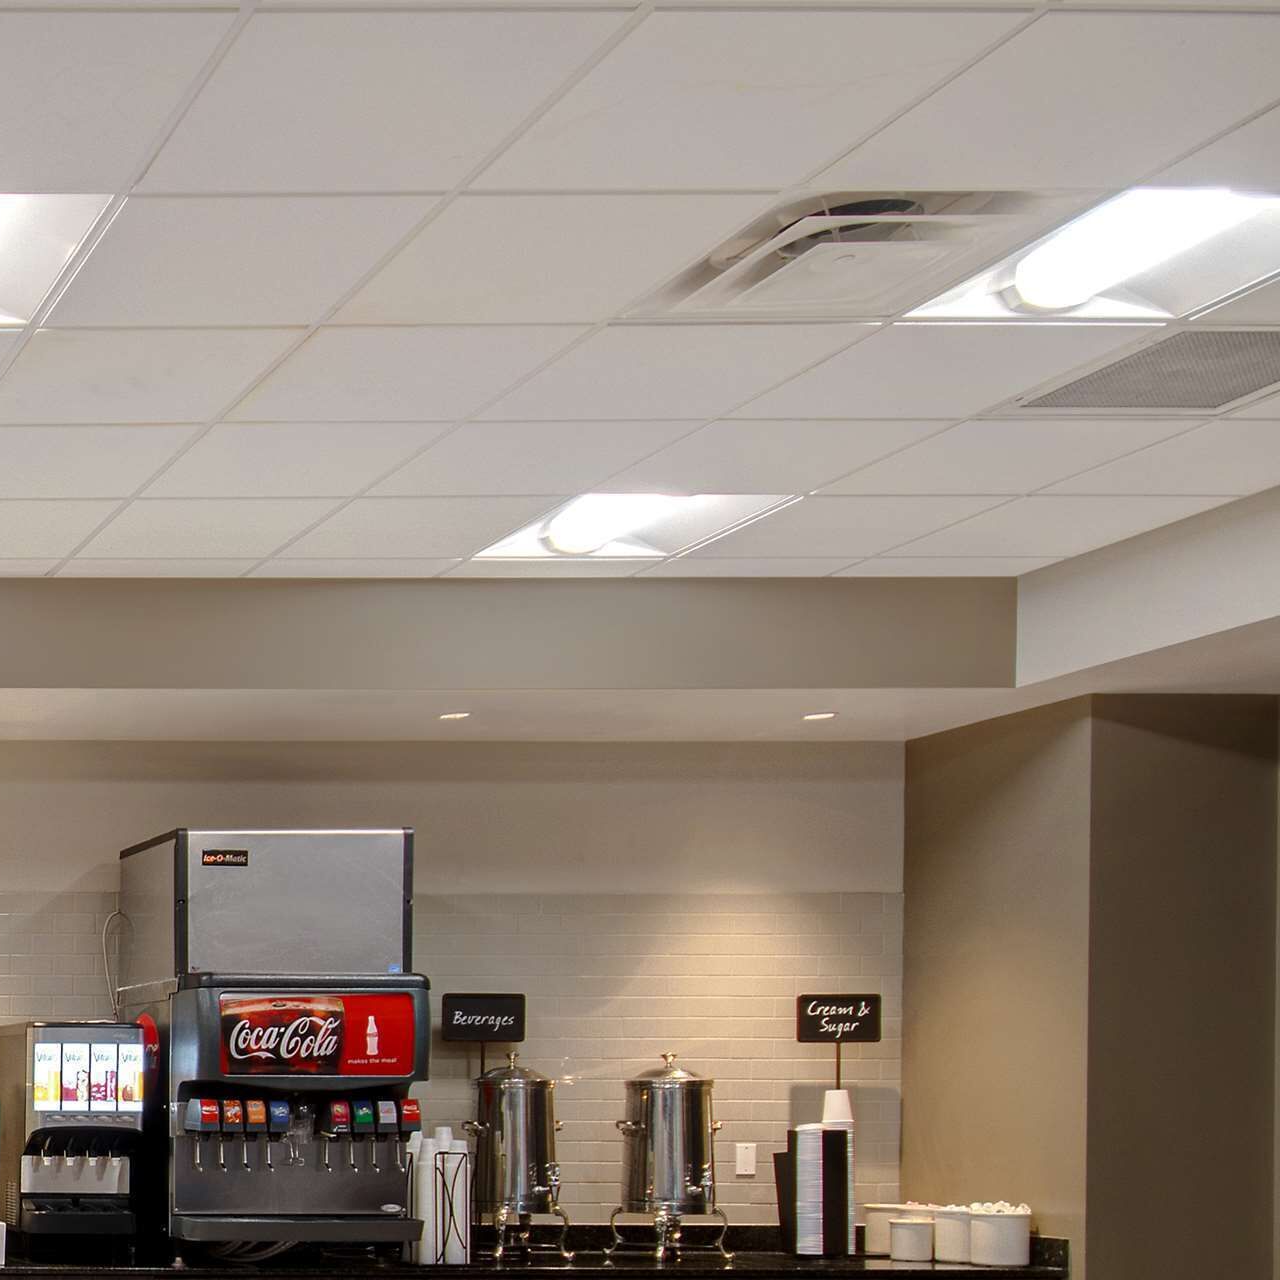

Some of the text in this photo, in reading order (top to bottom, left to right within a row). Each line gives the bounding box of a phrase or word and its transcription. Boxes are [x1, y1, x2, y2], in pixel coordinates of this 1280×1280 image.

[807, 1000, 871, 1017] Cream &
[452, 1010, 515, 1032] Beverages
[819, 1017, 860, 1039] Sugar
[229, 1016, 341, 1059] Coca-Cola
